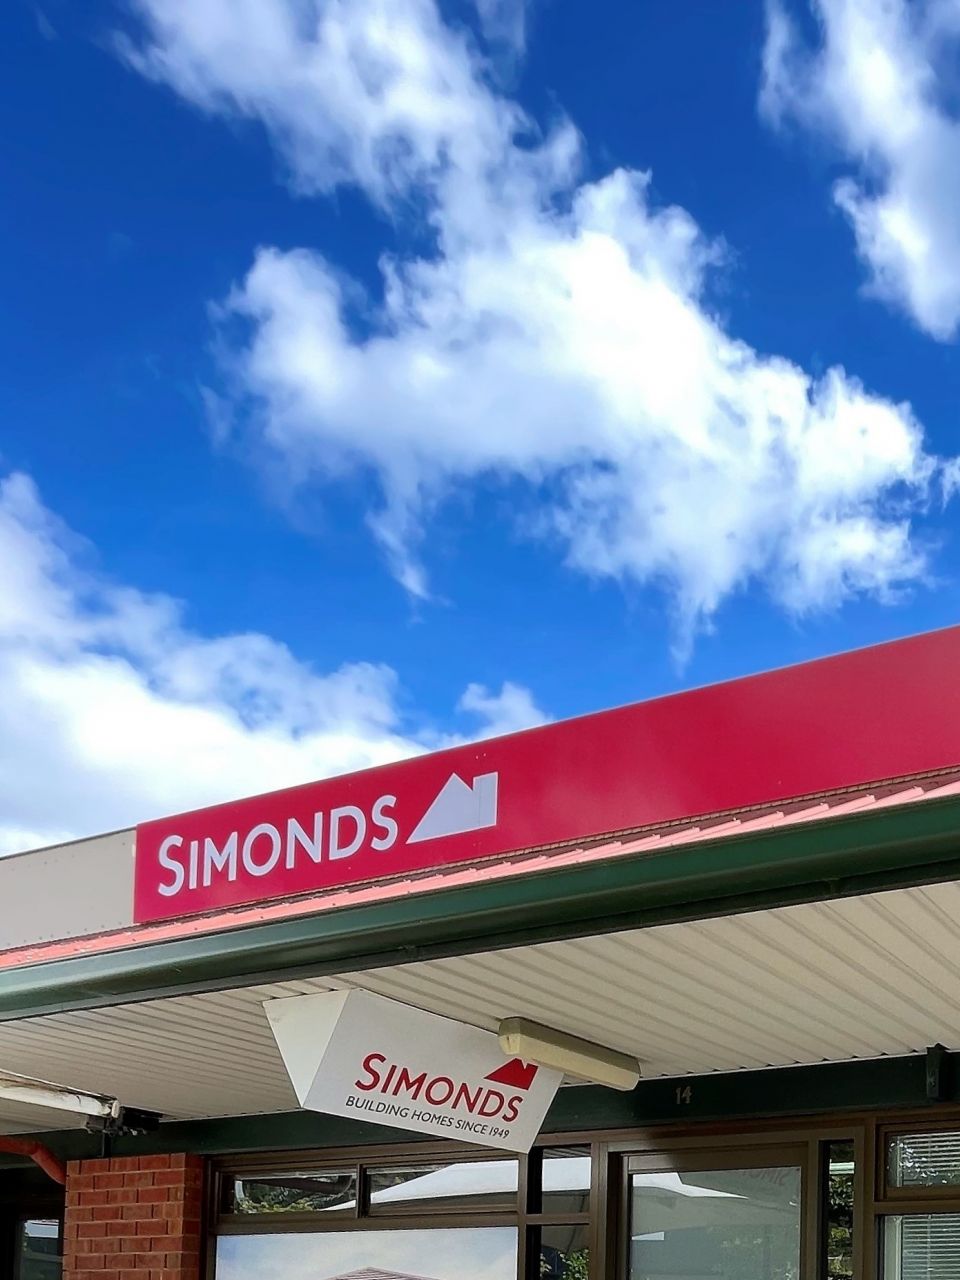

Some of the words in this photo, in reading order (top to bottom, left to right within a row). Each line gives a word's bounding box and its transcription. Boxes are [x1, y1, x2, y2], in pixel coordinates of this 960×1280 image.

[157, 794, 399, 896] SIMONDS
[355, 1053, 524, 1122] SIMONDS
[675, 1086, 692, 1105] 14
[346, 1096, 410, 1118] BUILDING
[411, 1110, 454, 1127] HOMES
[455, 1119, 491, 1135] SINCE
[489, 1126, 510, 1139] 1949
